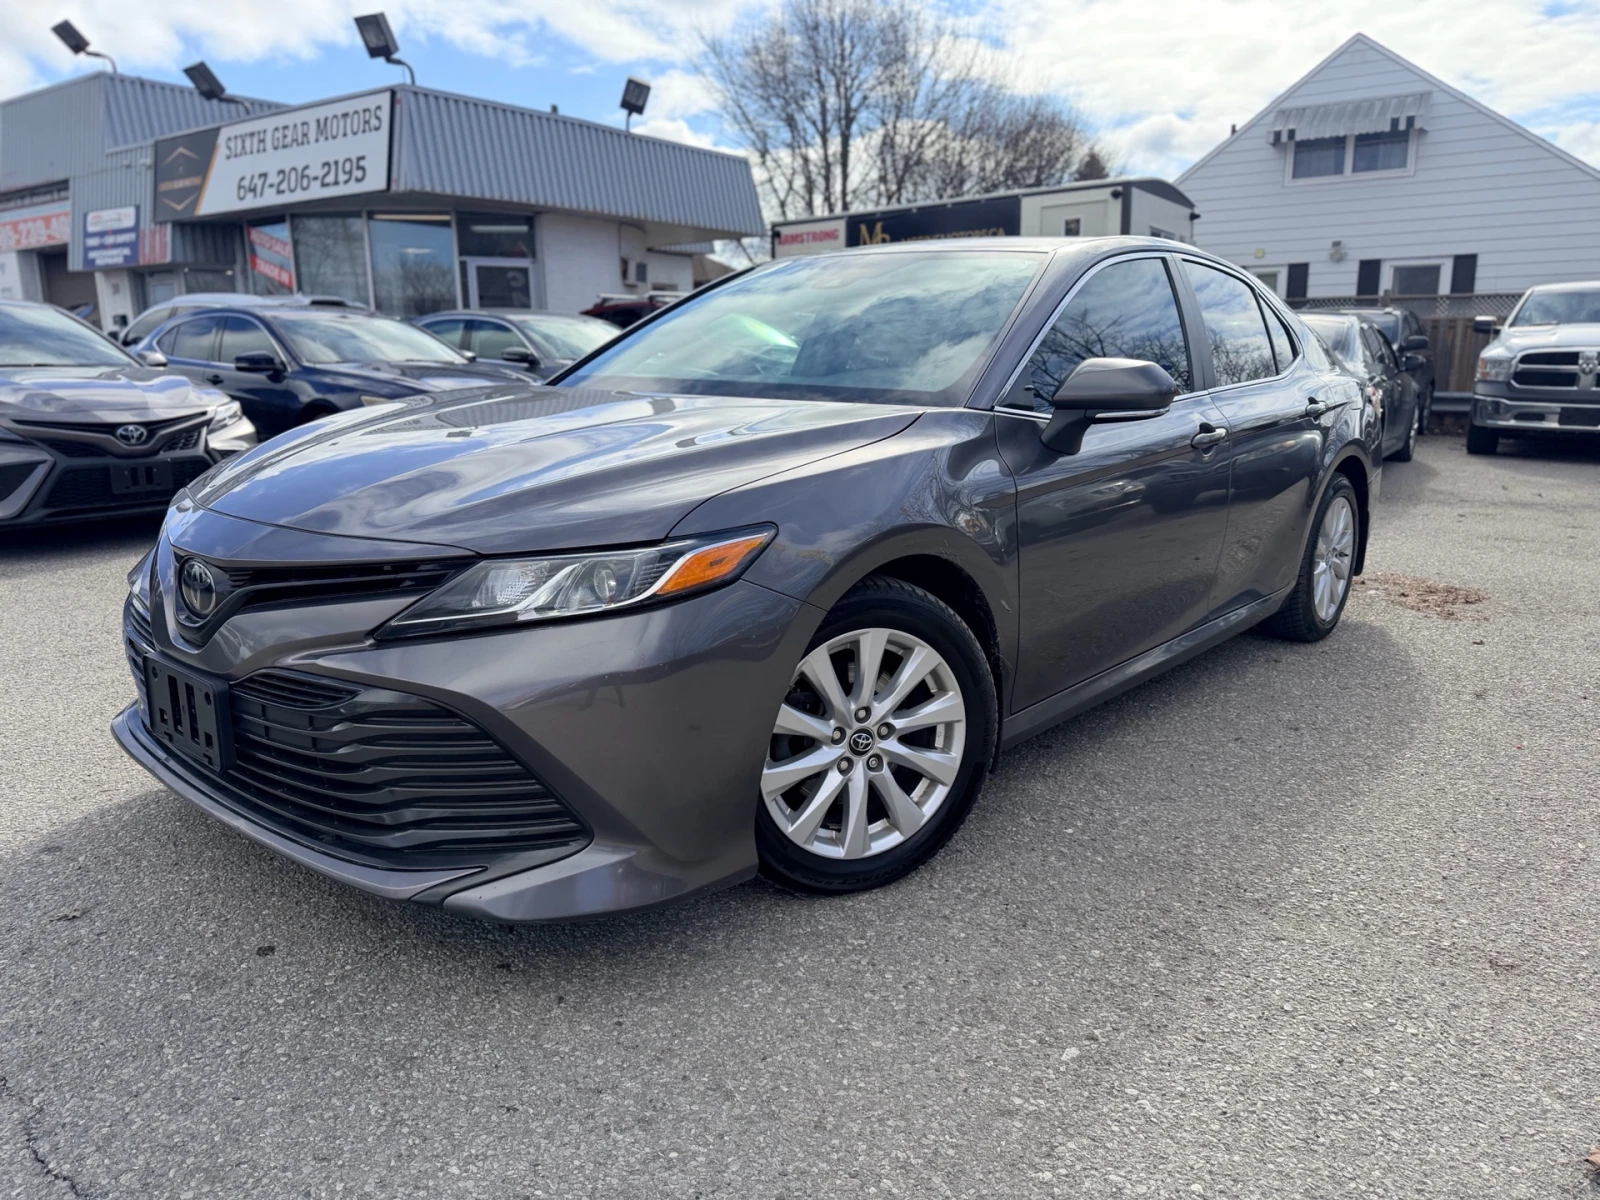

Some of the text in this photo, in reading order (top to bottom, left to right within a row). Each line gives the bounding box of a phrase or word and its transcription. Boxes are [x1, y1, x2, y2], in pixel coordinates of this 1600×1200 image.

[225, 105, 383, 160] SIXTH GEAR MOTORS
[236, 156, 366, 201] 647-206-2195
[778, 228, 839, 245] ARMSTRONG
